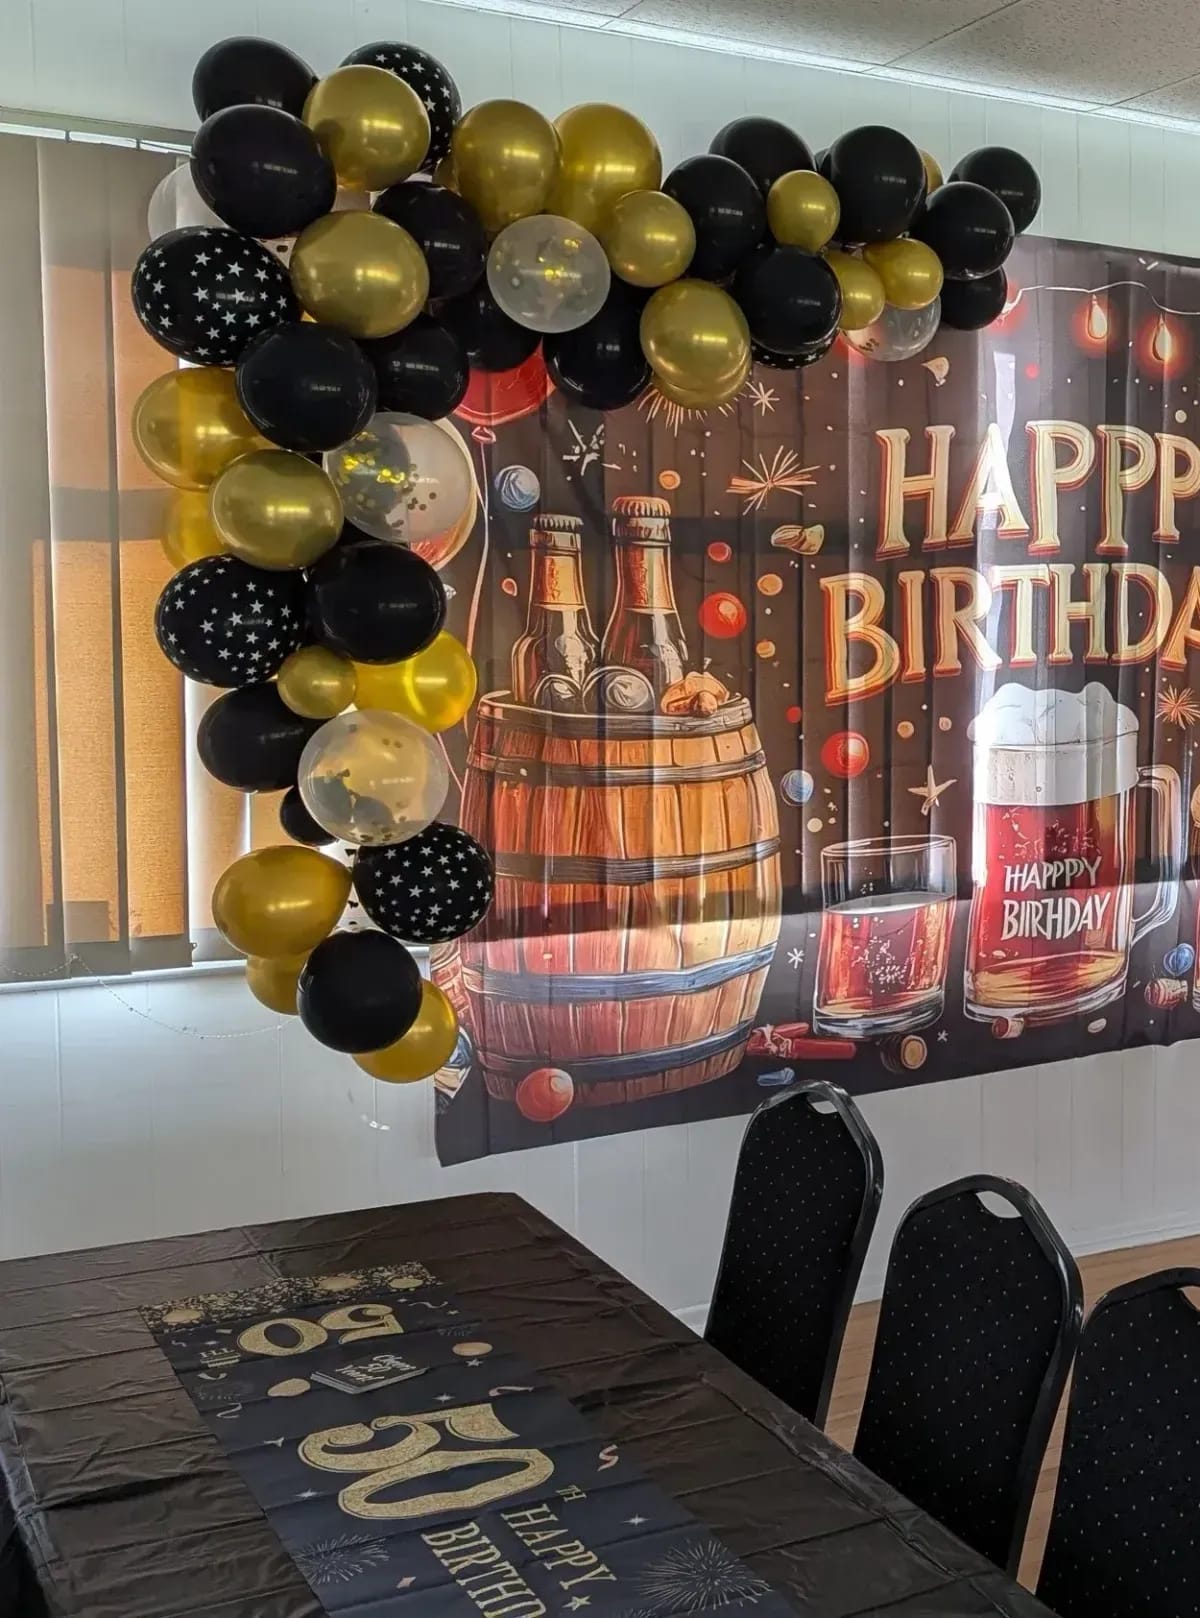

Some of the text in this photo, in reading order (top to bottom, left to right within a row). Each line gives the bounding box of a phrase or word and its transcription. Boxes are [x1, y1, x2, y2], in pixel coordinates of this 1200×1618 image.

[238, 1303, 404, 1357] 50
[298, 1403, 554, 1520] 50
[501, 1503, 617, 1590] HAPPY
